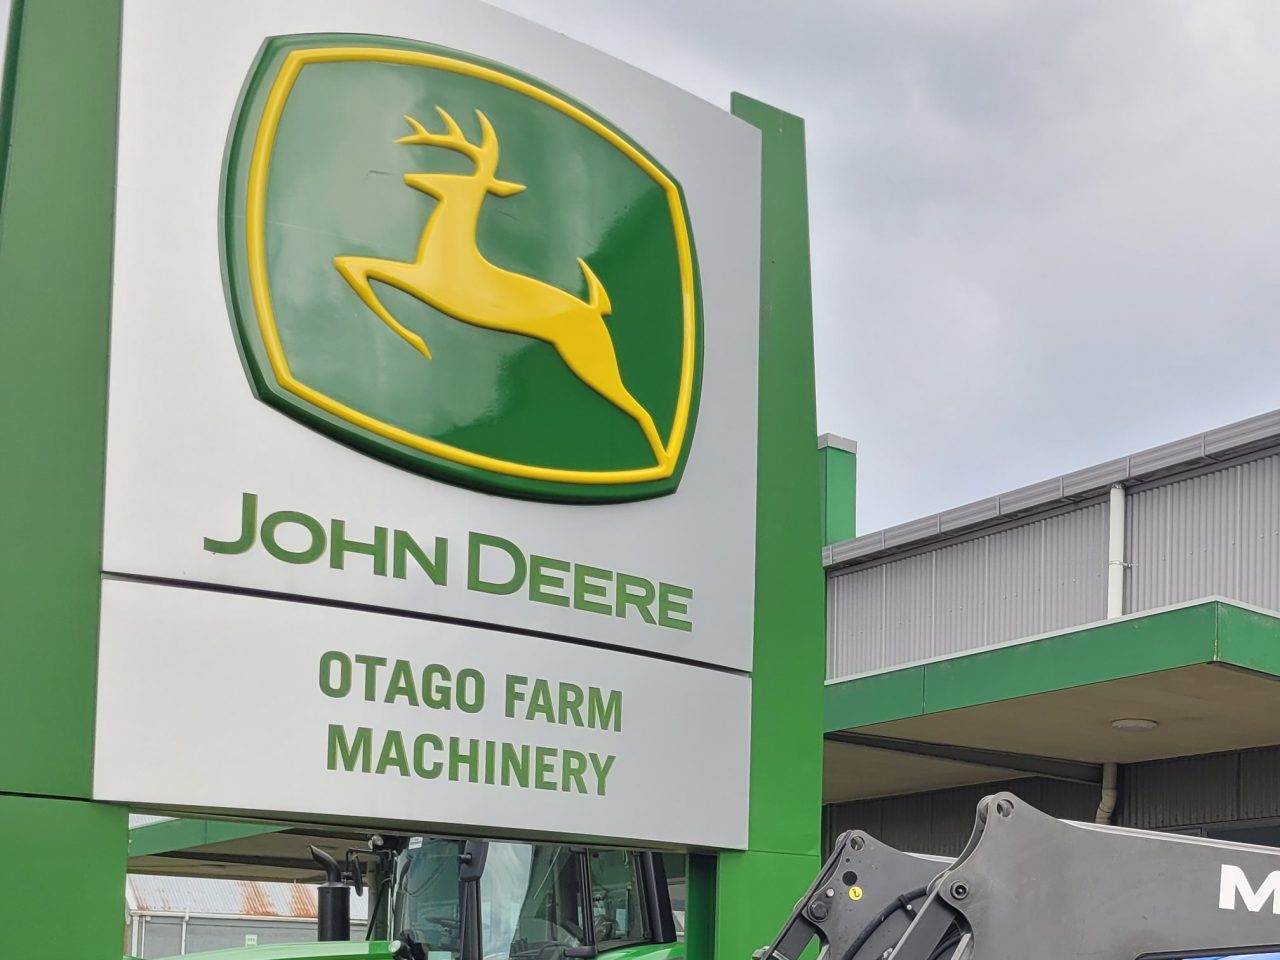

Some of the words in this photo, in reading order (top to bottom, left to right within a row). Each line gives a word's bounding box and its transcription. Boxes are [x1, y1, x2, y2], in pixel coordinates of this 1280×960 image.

[203, 492, 448, 586] JOHN
[467, 531, 693, 632] DEERE
[318, 650, 485, 714] OTAGO
[504, 674, 622, 732] FARM
[326, 724, 616, 796] MACHINERY
